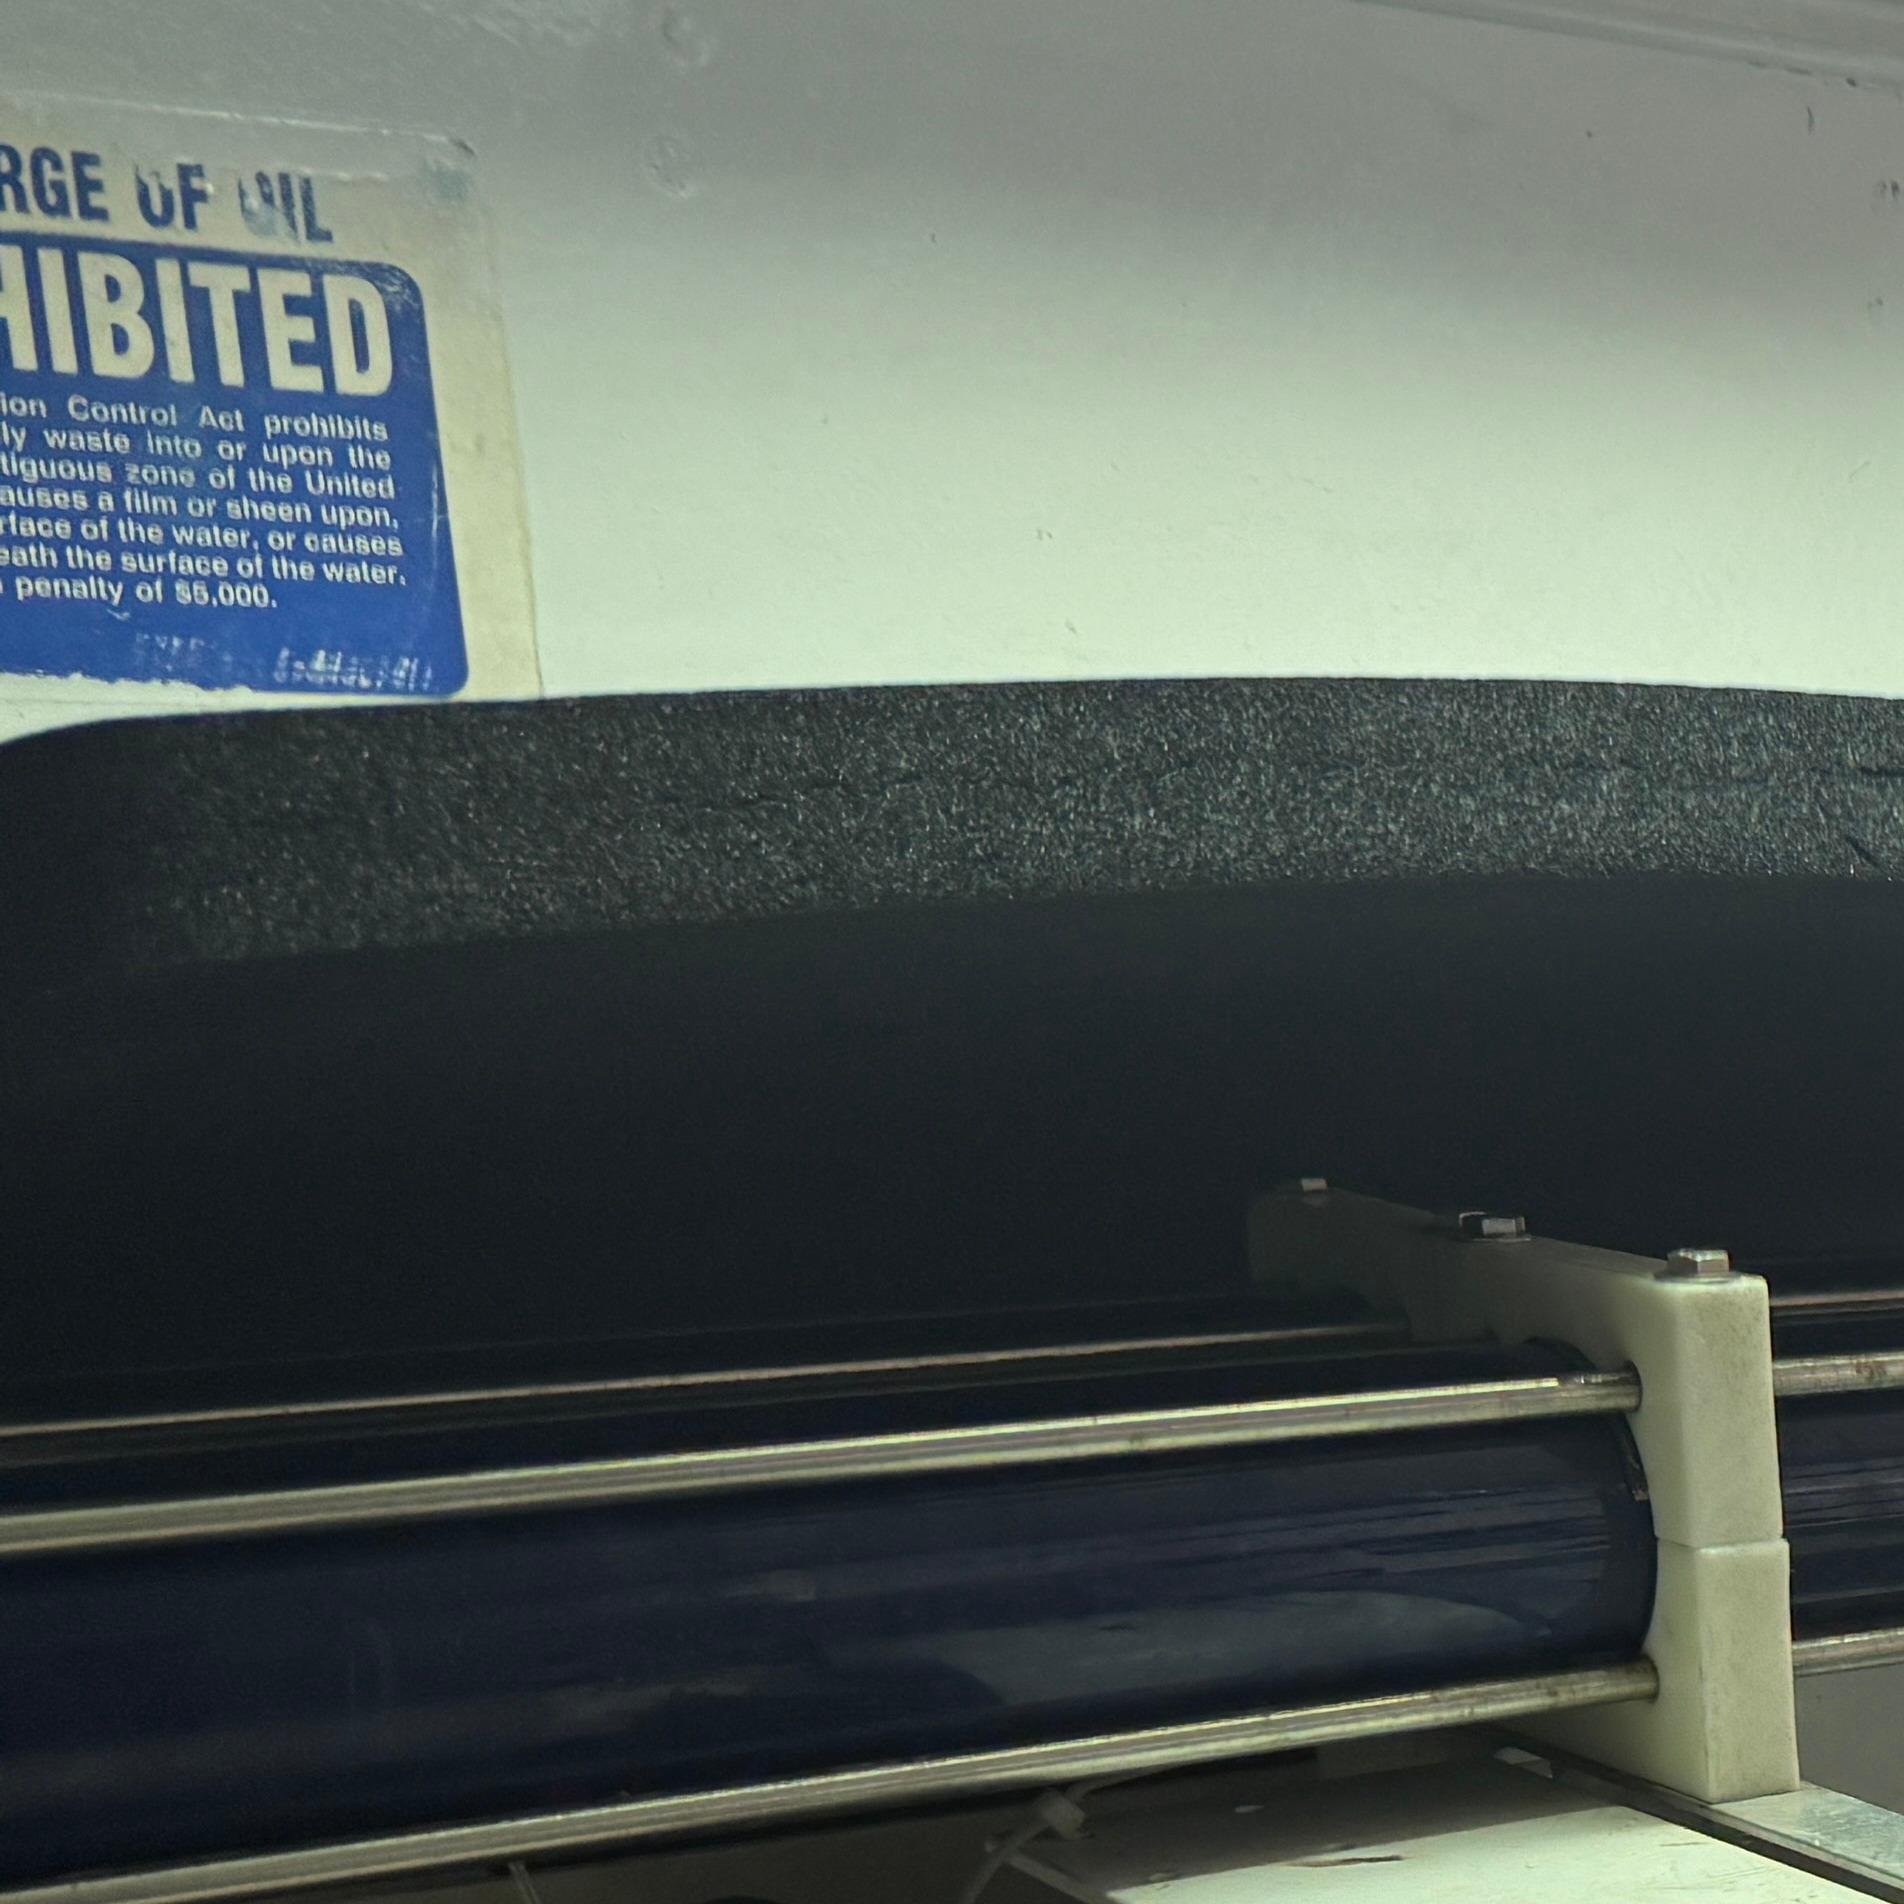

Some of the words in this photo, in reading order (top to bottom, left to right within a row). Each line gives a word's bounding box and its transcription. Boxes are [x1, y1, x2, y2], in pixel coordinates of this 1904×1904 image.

[133, 162, 209, 231] OF
[67, 394, 177, 427] Control
[199, 405, 246, 432] Act
[264, 412, 389, 441] prohibits
[43, 427, 131, 454] waste
[147, 430, 202, 459] into
[217, 439, 247, 462] or
[262, 443, 334, 470] upon
[349, 444, 392, 471] the
[125, 462, 196, 488] zone
[208, 464, 235, 490] of
[248, 467, 293, 493] the
[304, 469, 395, 500] United
[98, 490, 115, 514] a
[123, 487, 178, 516] film
[187, 496, 217, 518] or
[226, 495, 313, 523] sheen
[80, 514, 109, 542] of
[118, 516, 165, 546] the
[267, 529, 297, 551] or
[304, 531, 405, 557] causes
[66, 544, 113, 572] the
[121, 548, 229, 578] surface
[236, 552, 264, 579] of
[271, 554, 316, 581] the
[15, 575, 124, 607] penalty
[135, 577, 163, 604] of
